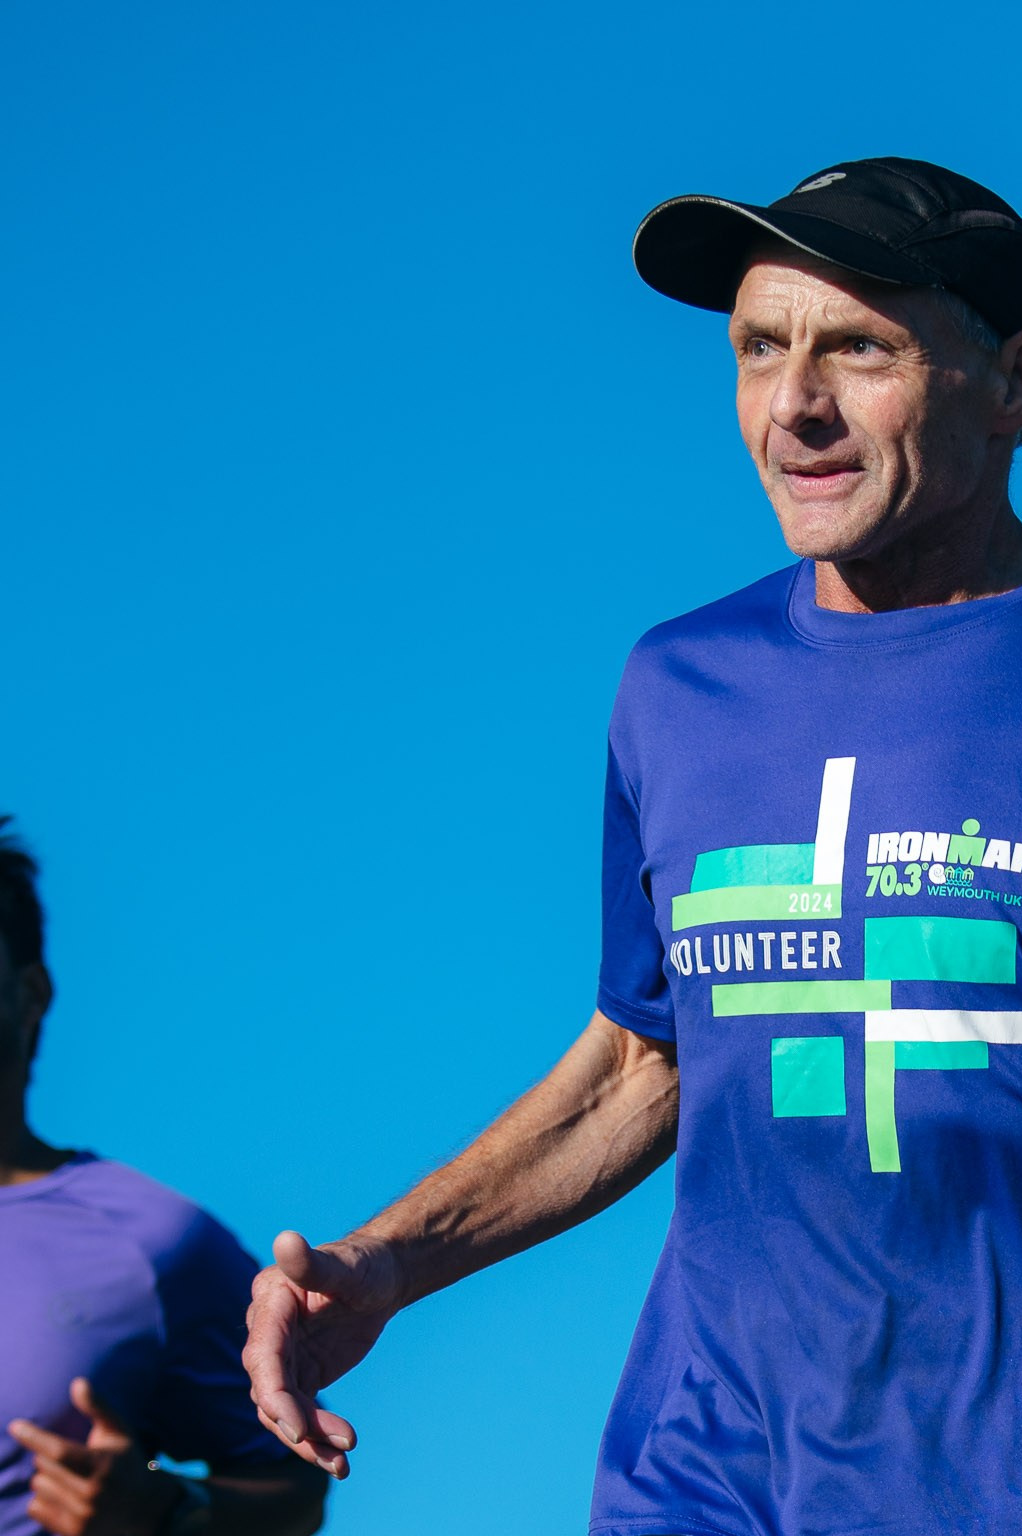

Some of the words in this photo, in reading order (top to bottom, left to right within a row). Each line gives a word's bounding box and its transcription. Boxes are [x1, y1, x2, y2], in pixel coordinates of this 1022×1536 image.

[865, 863, 922, 898] 70.3
[788, 892, 833, 913] 2024
[927, 885, 1000, 902] WEYMOUTH
[1003, 893, 1022, 907] UK
